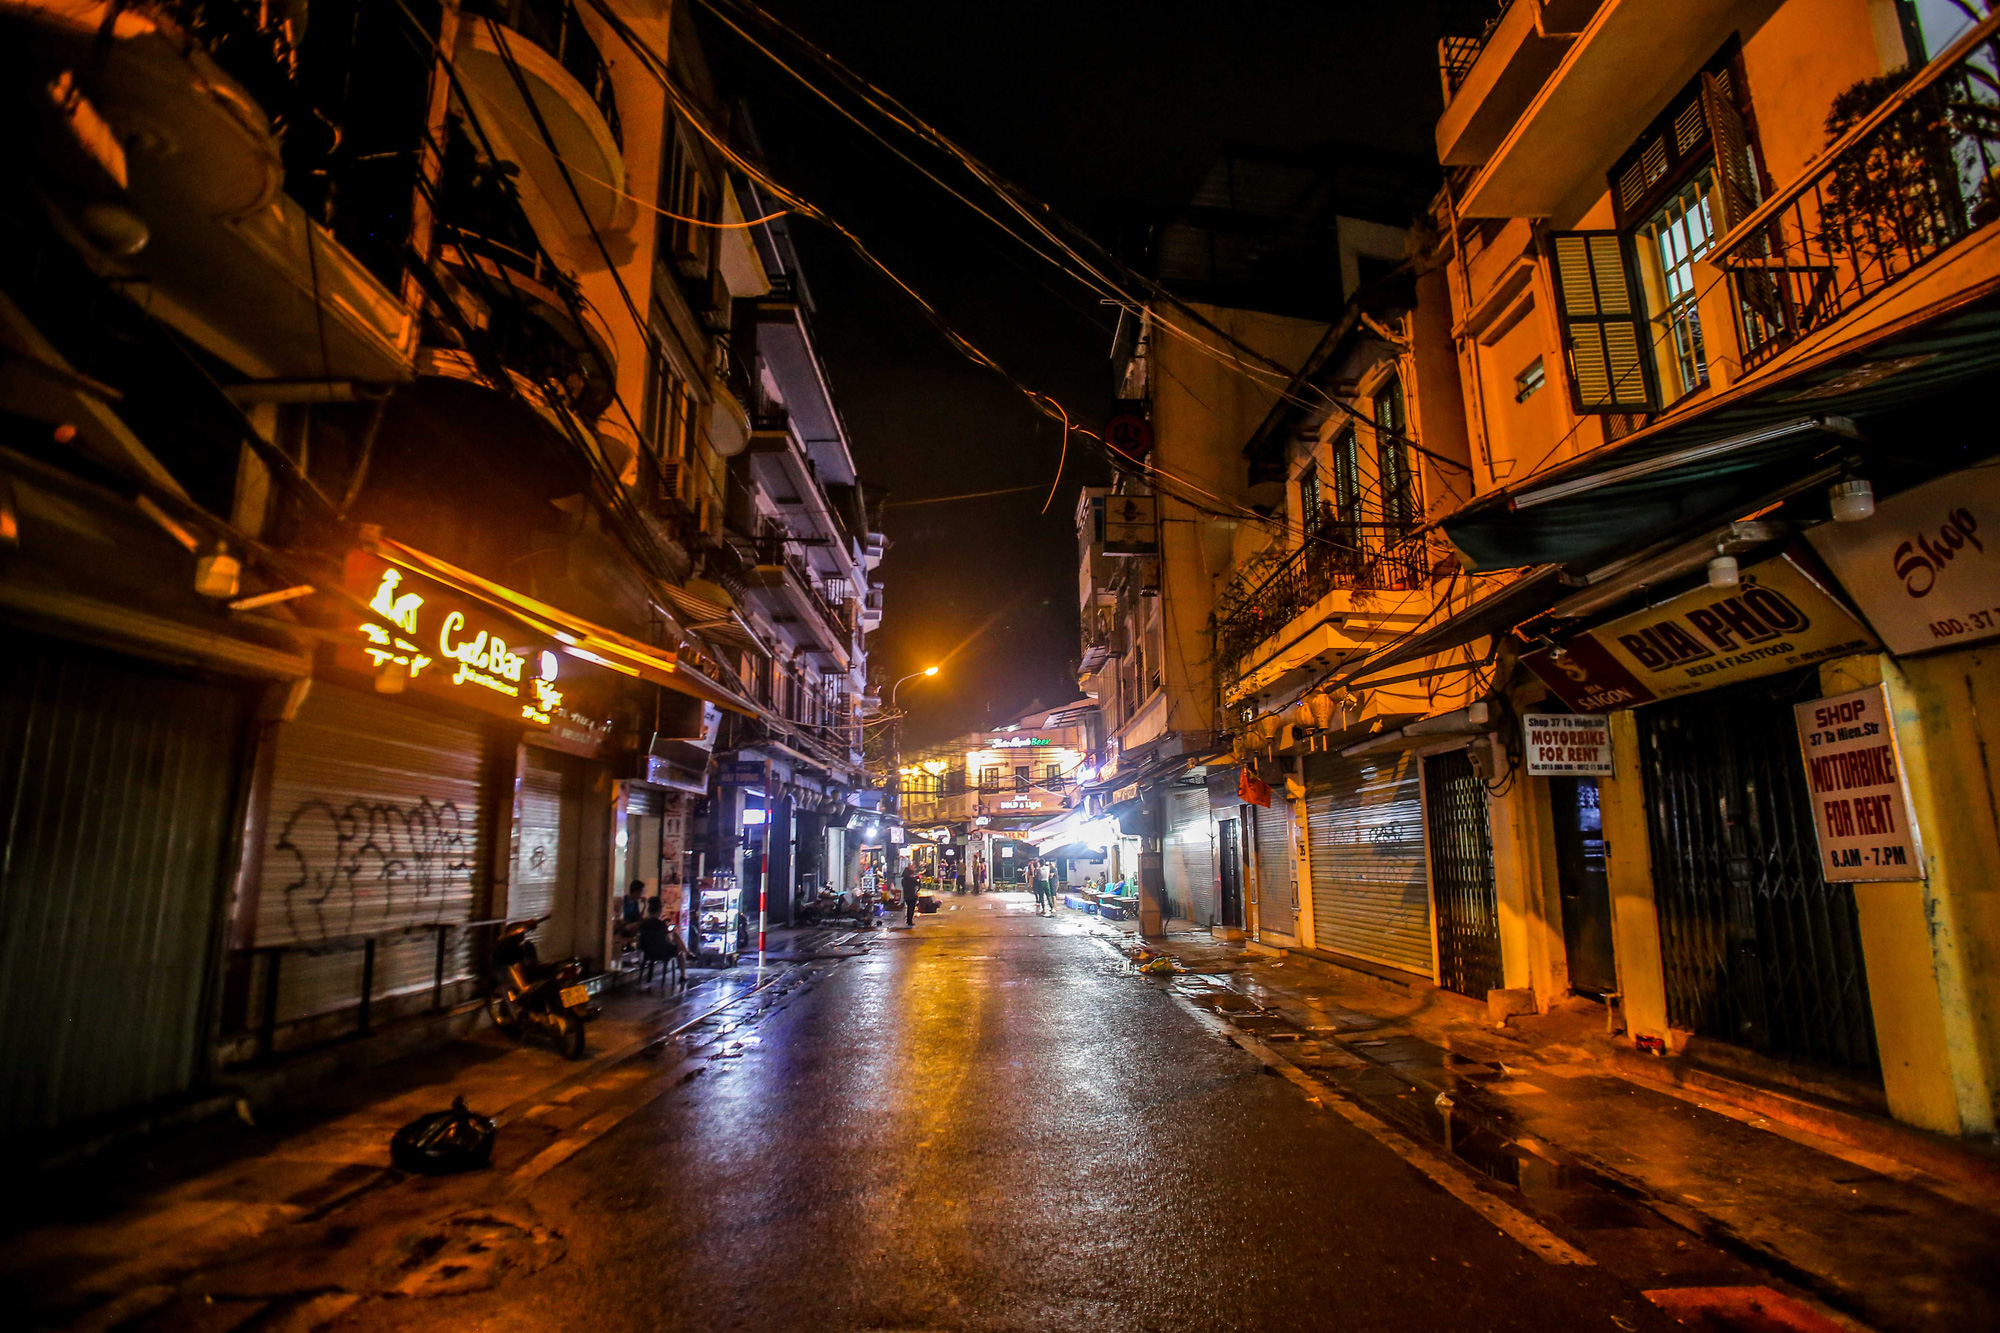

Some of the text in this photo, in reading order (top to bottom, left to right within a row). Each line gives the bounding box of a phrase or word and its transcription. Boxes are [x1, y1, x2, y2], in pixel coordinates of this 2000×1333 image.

[1894, 507, 1984, 598] Shop
[1618, 620, 1714, 672] BIA
[1717, 659, 1726, 670] &
[1725, 641, 1796, 667] FASTFOOD
[1577, 687, 1636, 711] SAIGON
[1528, 717, 1548, 728] Shop
[1551, 717, 1560, 727] 37
[1815, 699, 1866, 729] SHOP
[1531, 730, 1606, 746] MOTORBIKE
[1809, 732, 1823, 747] 37
[1824, 729, 1836, 744] Ta
[1539, 747, 1599, 762] FOR RENT
[1810, 745, 1895, 794] MOTORBIKE
[1823, 794, 1895, 838] FOR RENT
[1831, 848, 1863, 867] 8.AM
[1871, 846, 1906, 866] 7.PM
